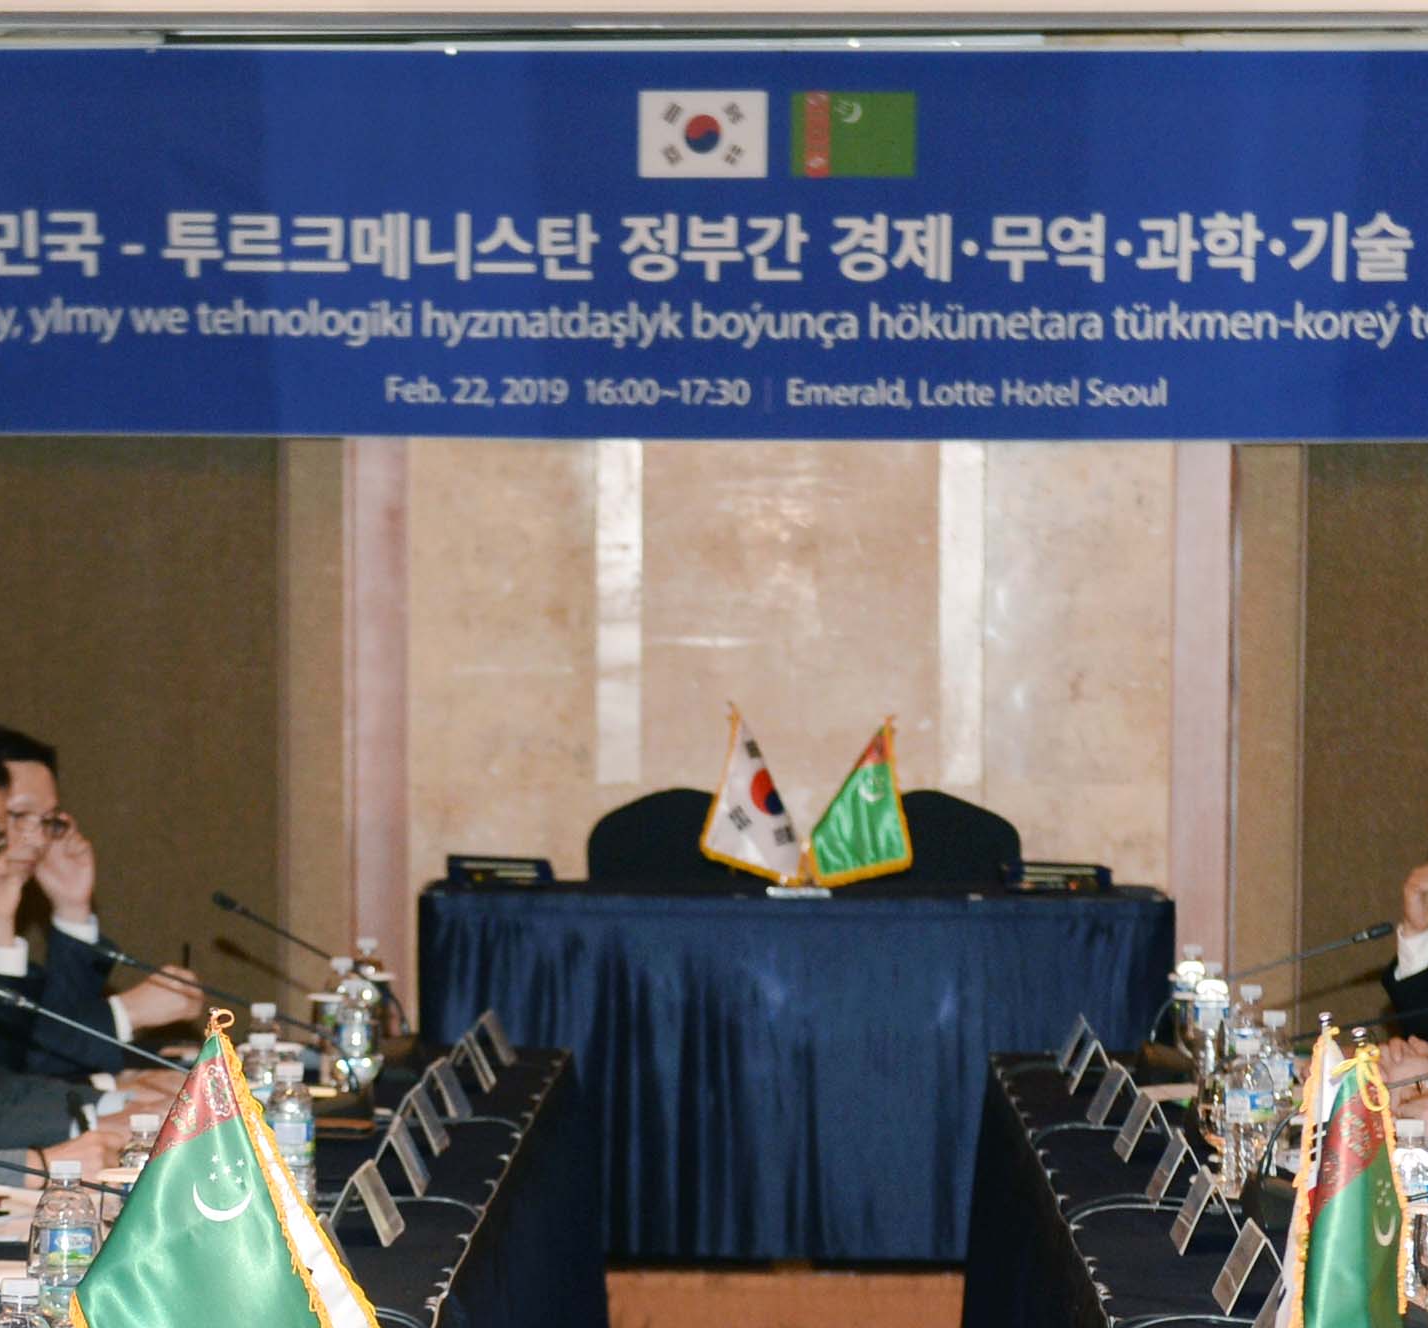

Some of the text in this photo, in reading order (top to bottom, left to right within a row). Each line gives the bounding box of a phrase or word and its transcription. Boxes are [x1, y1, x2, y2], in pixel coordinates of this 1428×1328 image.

[161, 209, 600, 281] 투르크메니스탄
[620, 211, 810, 282] 정부간
[28, 297, 125, 344] ylmy
[130, 307, 189, 335] we
[195, 299, 413, 348] tehnologiki
[421, 300, 685, 349] hyzmatdaşlyk
[869, 301, 1105, 340] hökümetara
[385, 375, 752, 407] Feb. 22, 2019 16:00~17:30
[786, 377, 1169, 409] Emerald, Lotte Hotel Seoul
